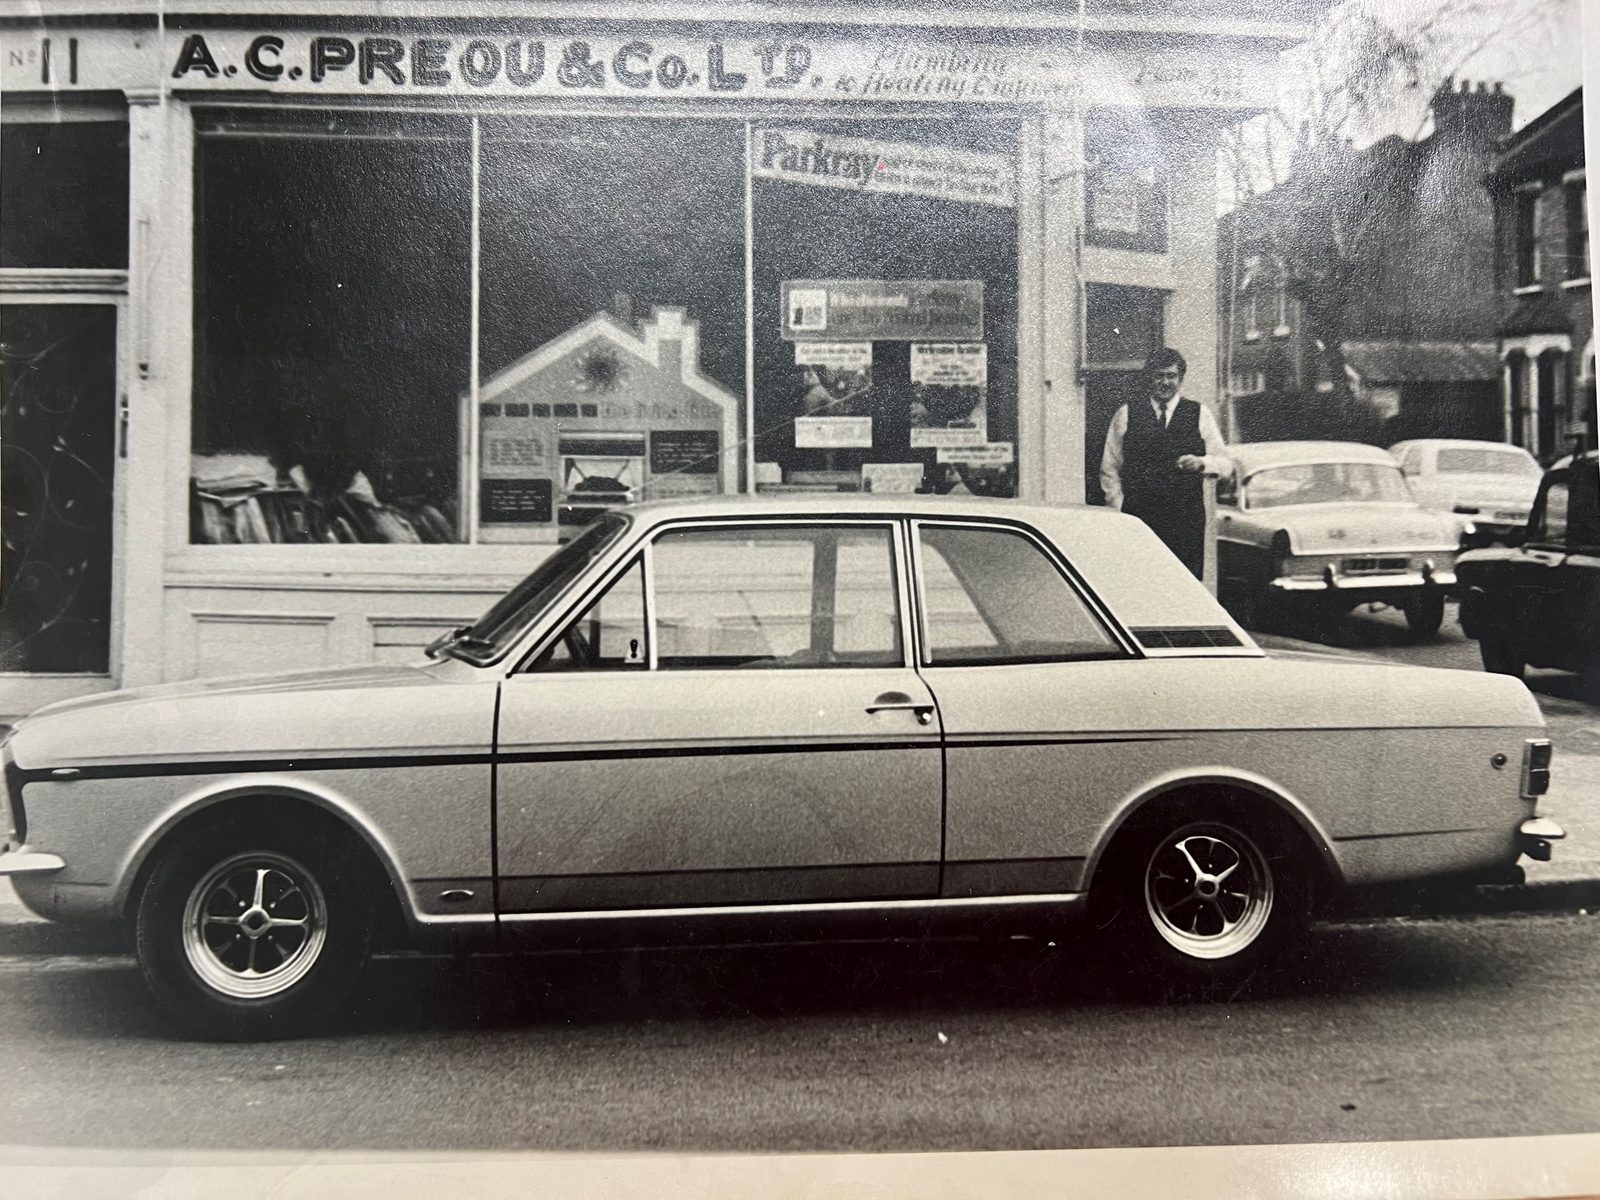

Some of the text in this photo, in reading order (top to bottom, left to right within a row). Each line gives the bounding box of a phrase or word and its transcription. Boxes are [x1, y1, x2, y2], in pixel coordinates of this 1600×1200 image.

[41, 38, 79, 84] 11
[556, 40, 606, 89] &
[761, 130, 879, 186] Parkray
